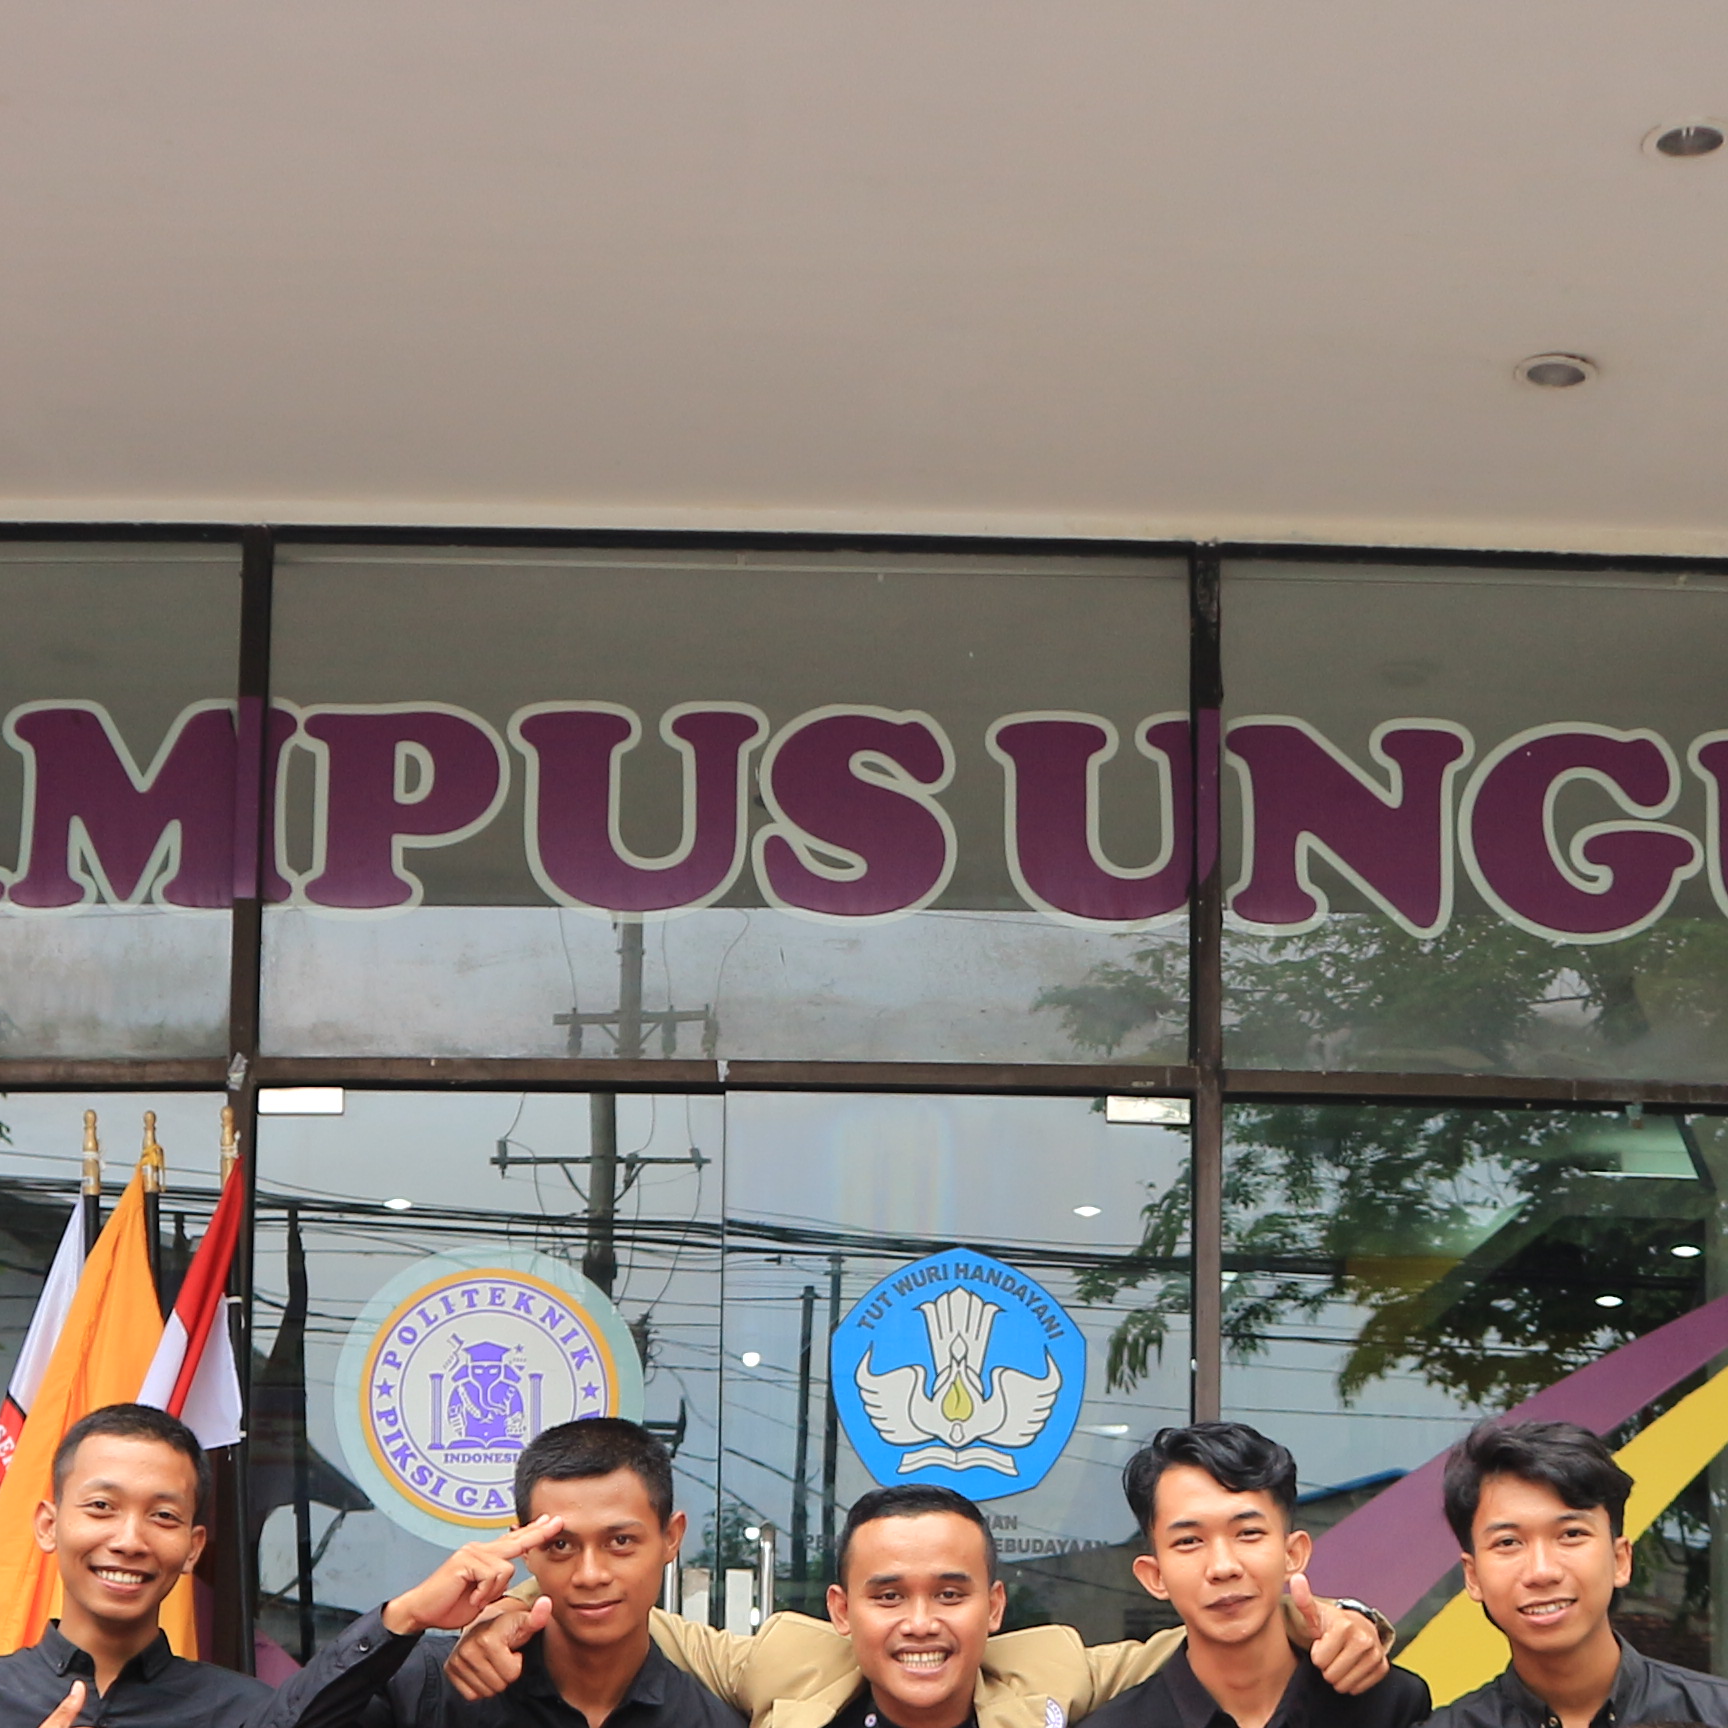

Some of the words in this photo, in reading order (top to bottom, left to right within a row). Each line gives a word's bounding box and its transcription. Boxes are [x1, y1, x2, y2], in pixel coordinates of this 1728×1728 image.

[382, 1287, 594, 1370] POLITEKNIK
[856, 1291, 894, 1331] TUT
[892, 1263, 949, 1296] WURI
[954, 1263, 1065, 1340] HANDAYANI
[376, 1407, 447, 1498] PIKSI
[443, 1452, 519, 1464] INDONESI
[994, 1537, 1109, 1554] EBUDAYAAN
